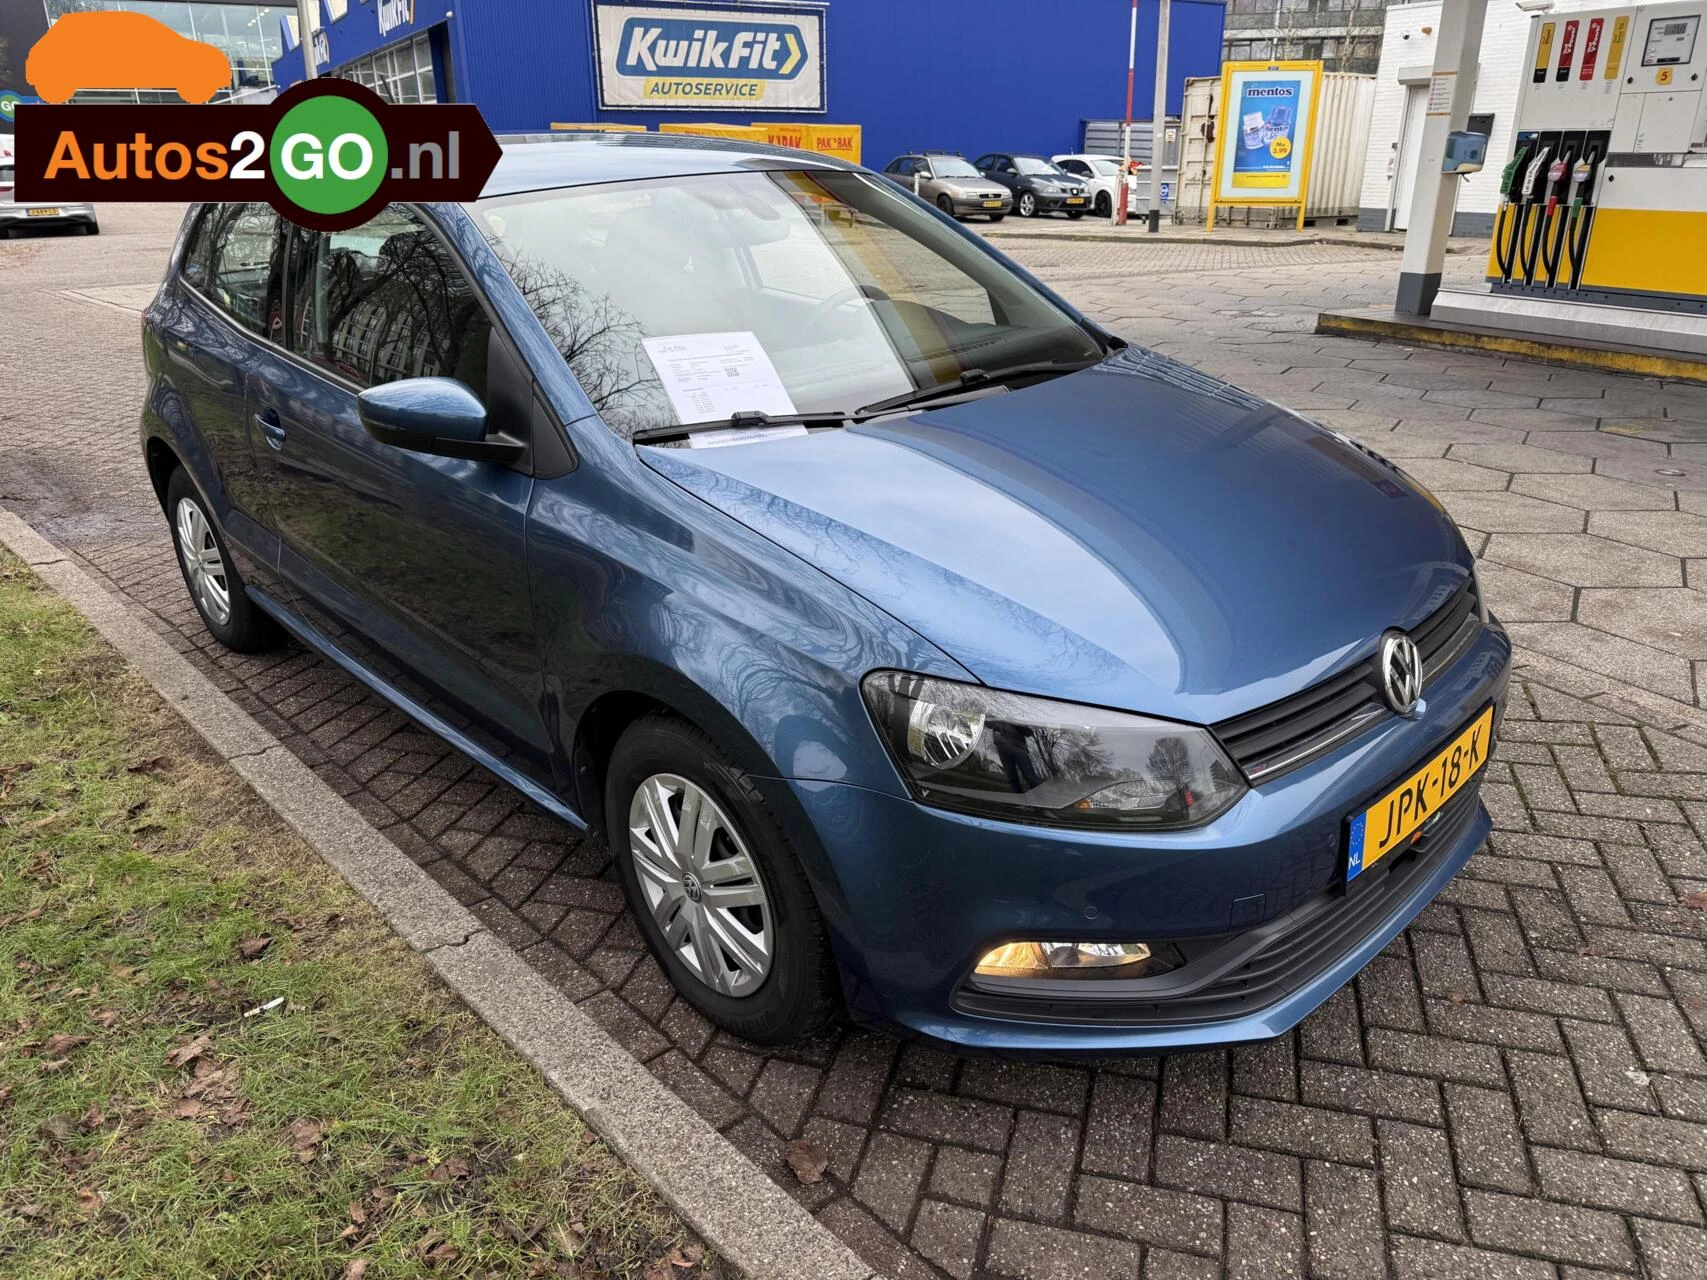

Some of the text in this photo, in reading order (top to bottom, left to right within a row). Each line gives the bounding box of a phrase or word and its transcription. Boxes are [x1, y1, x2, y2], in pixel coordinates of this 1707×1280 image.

[1661, 71, 1668, 81] 5
[650, 82, 758, 97] AUTOSERVICE
[1248, 88, 1292, 96] mentos
[1379, 724, 1482, 849] JPK-18-K
[1349, 856, 1361, 869] NL
